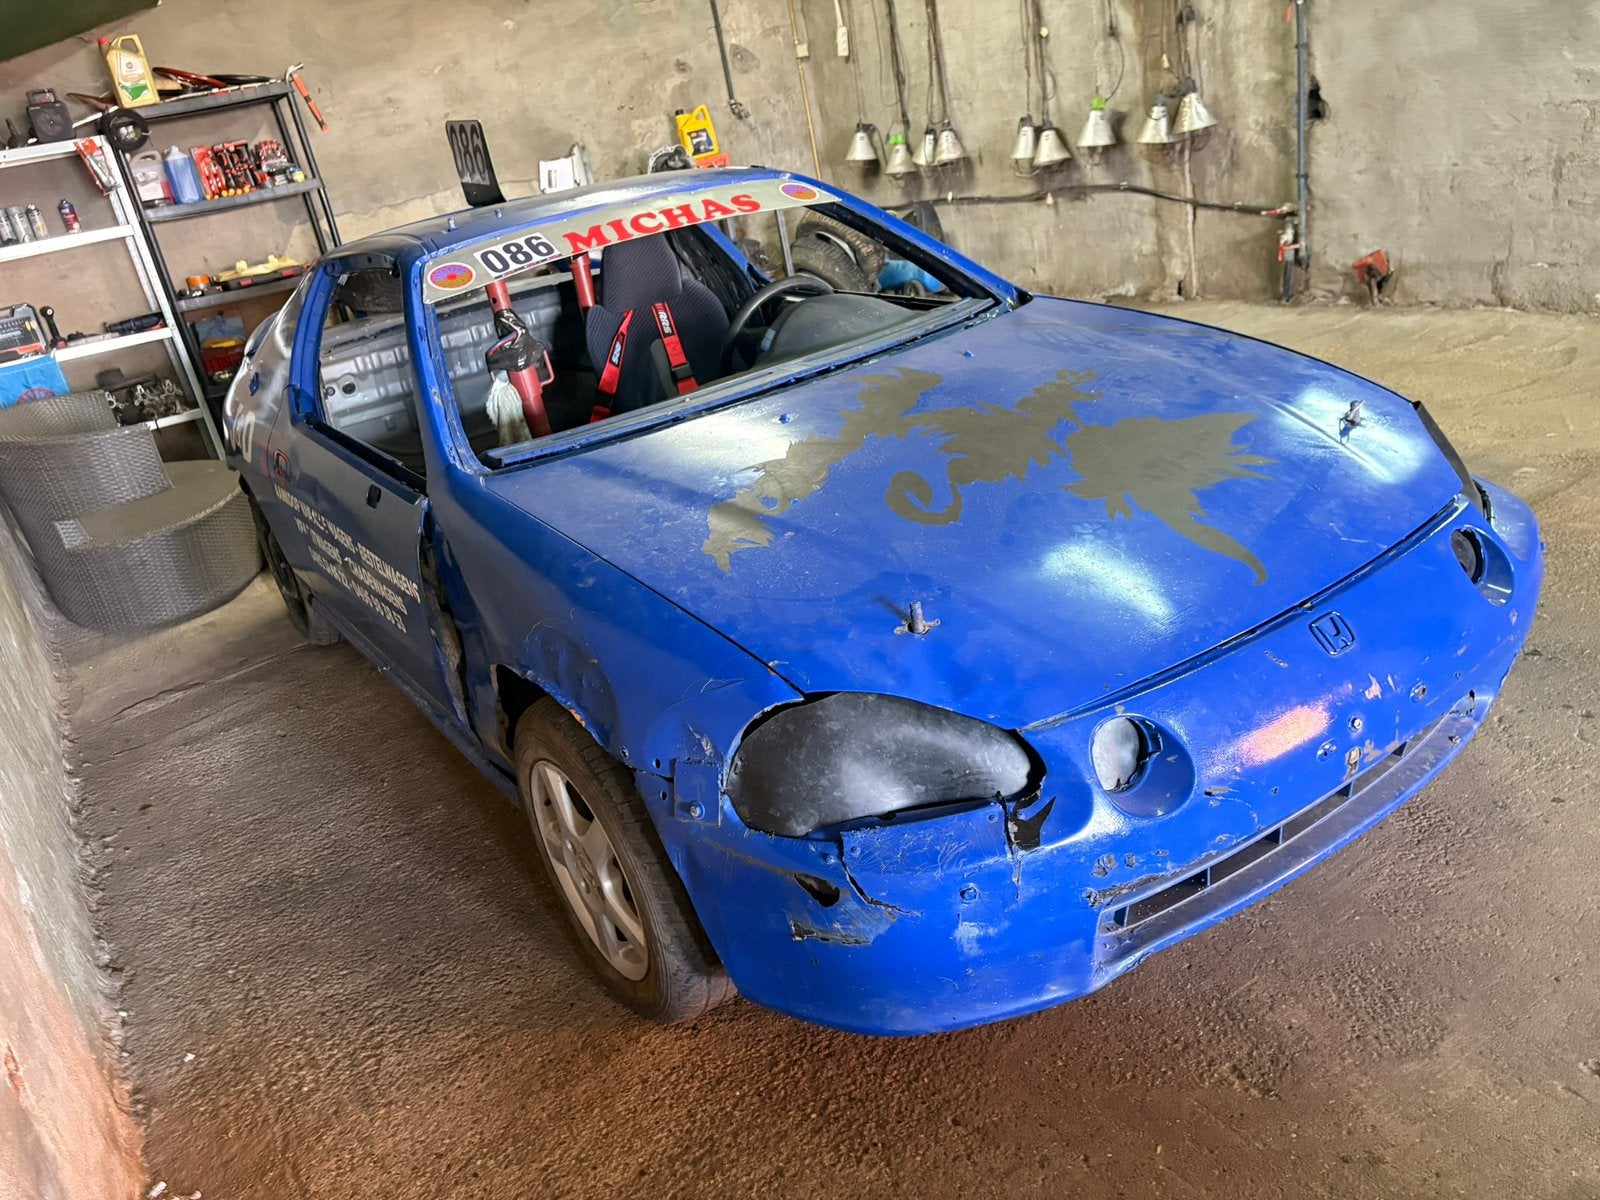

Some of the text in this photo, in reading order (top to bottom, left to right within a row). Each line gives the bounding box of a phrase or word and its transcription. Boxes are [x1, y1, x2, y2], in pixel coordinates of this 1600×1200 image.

[450, 124, 487, 181] 086
[562, 194, 761, 253] MICHAS
[481, 236, 555, 273] 086
